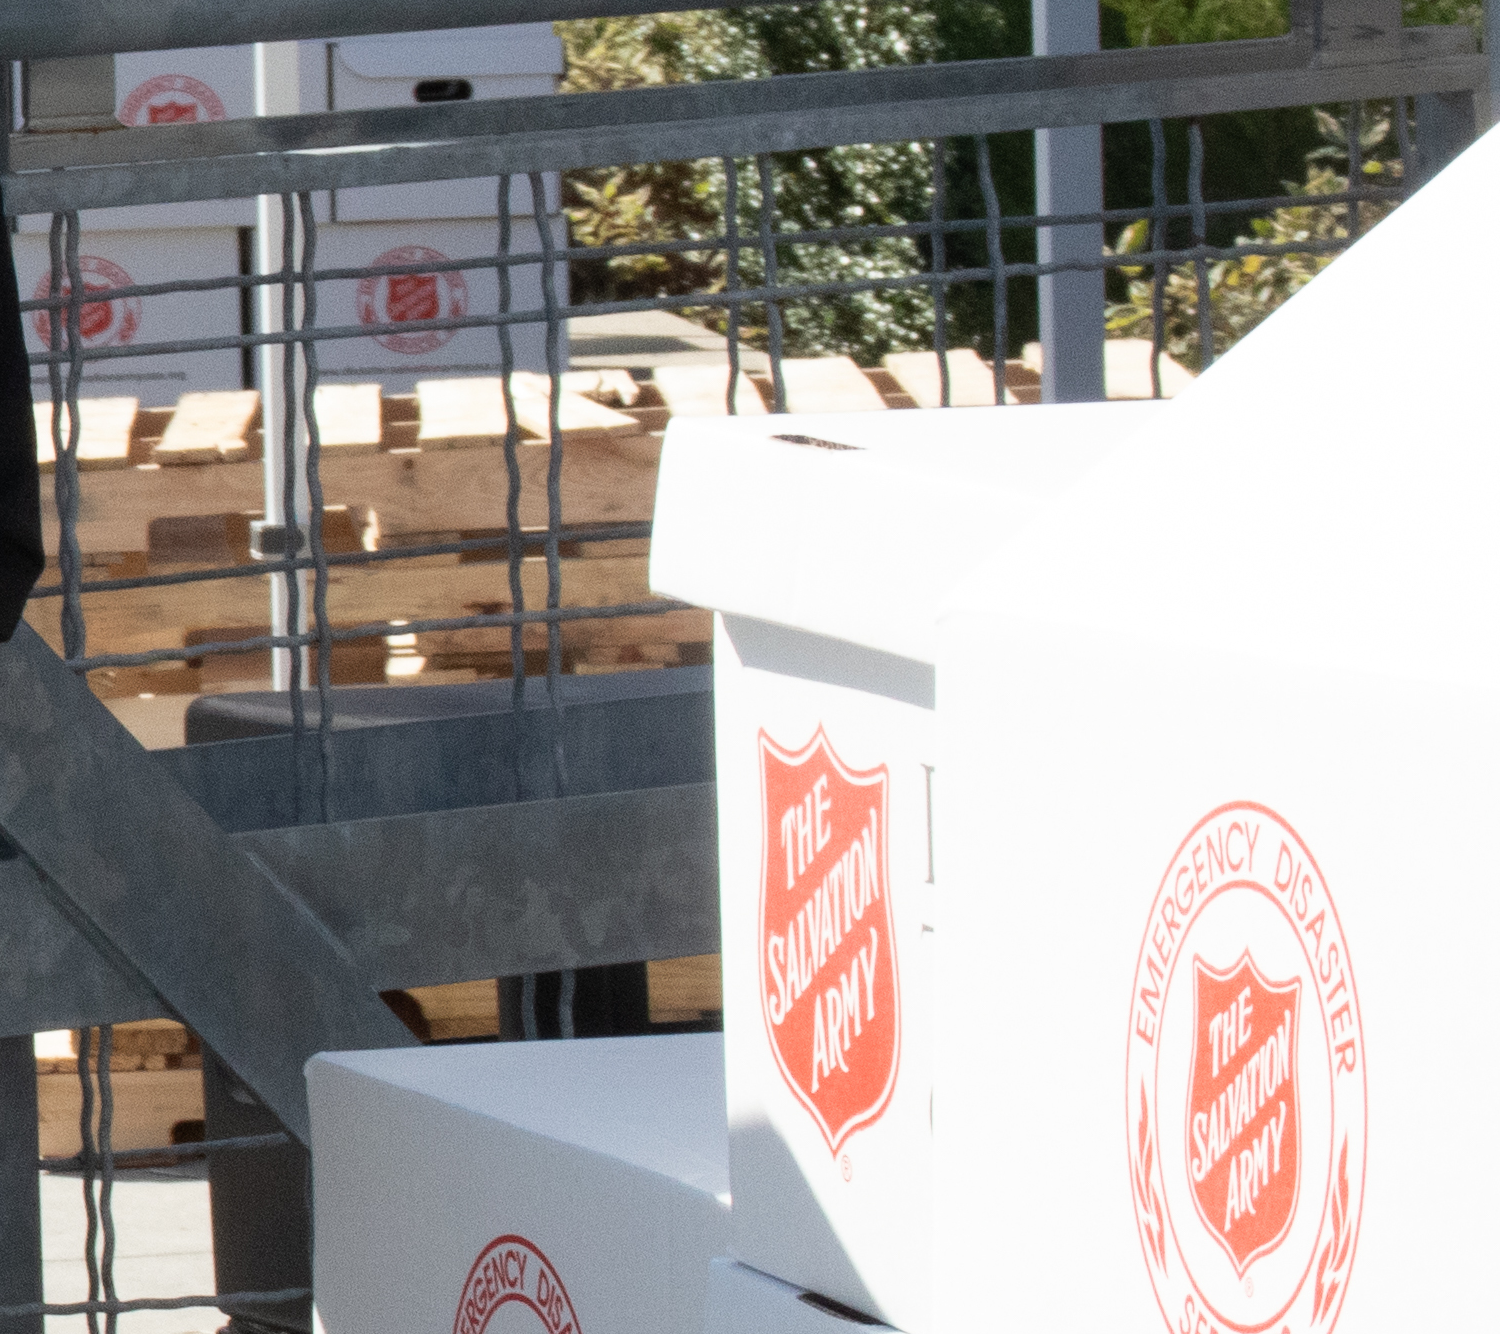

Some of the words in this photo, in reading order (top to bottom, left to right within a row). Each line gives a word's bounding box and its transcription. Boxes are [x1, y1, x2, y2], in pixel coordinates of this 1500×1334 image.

[781, 773, 832, 891] THE
[768, 807, 880, 1026] SALVATION
[1135, 821, 1261, 1048] EMERGENCY
[1273, 839, 1356, 1078] DISASTER
[811, 926, 878, 1094] ARMY
[1209, 985, 1254, 1079] THE
[1192, 1009, 1291, 1182] SALVATION
[1224, 1100, 1287, 1233] ARMY
